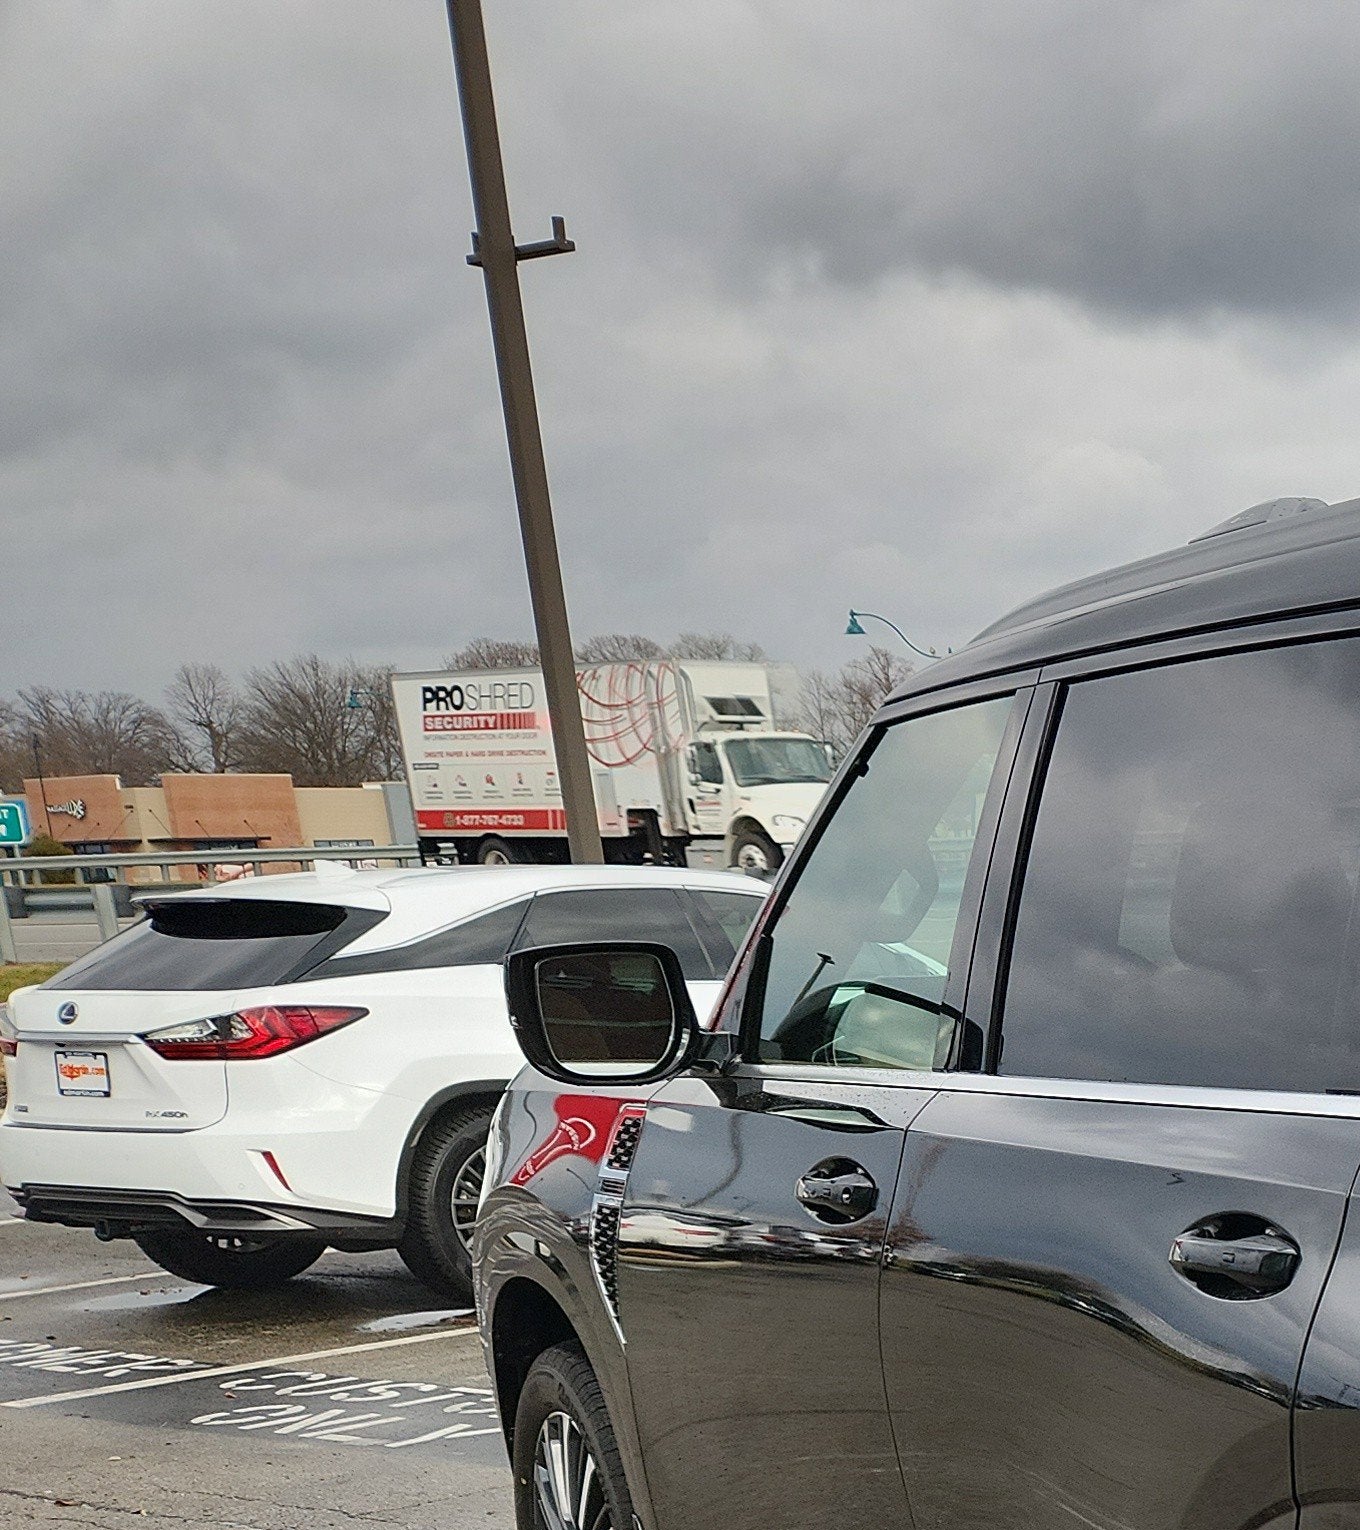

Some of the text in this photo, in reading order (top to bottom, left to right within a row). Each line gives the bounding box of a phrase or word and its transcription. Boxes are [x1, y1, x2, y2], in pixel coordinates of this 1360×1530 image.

[422, 682, 535, 711] PROSHRED
[425, 715, 496, 730] SECURITY
[161, 1110, 188, 1118] 450h
